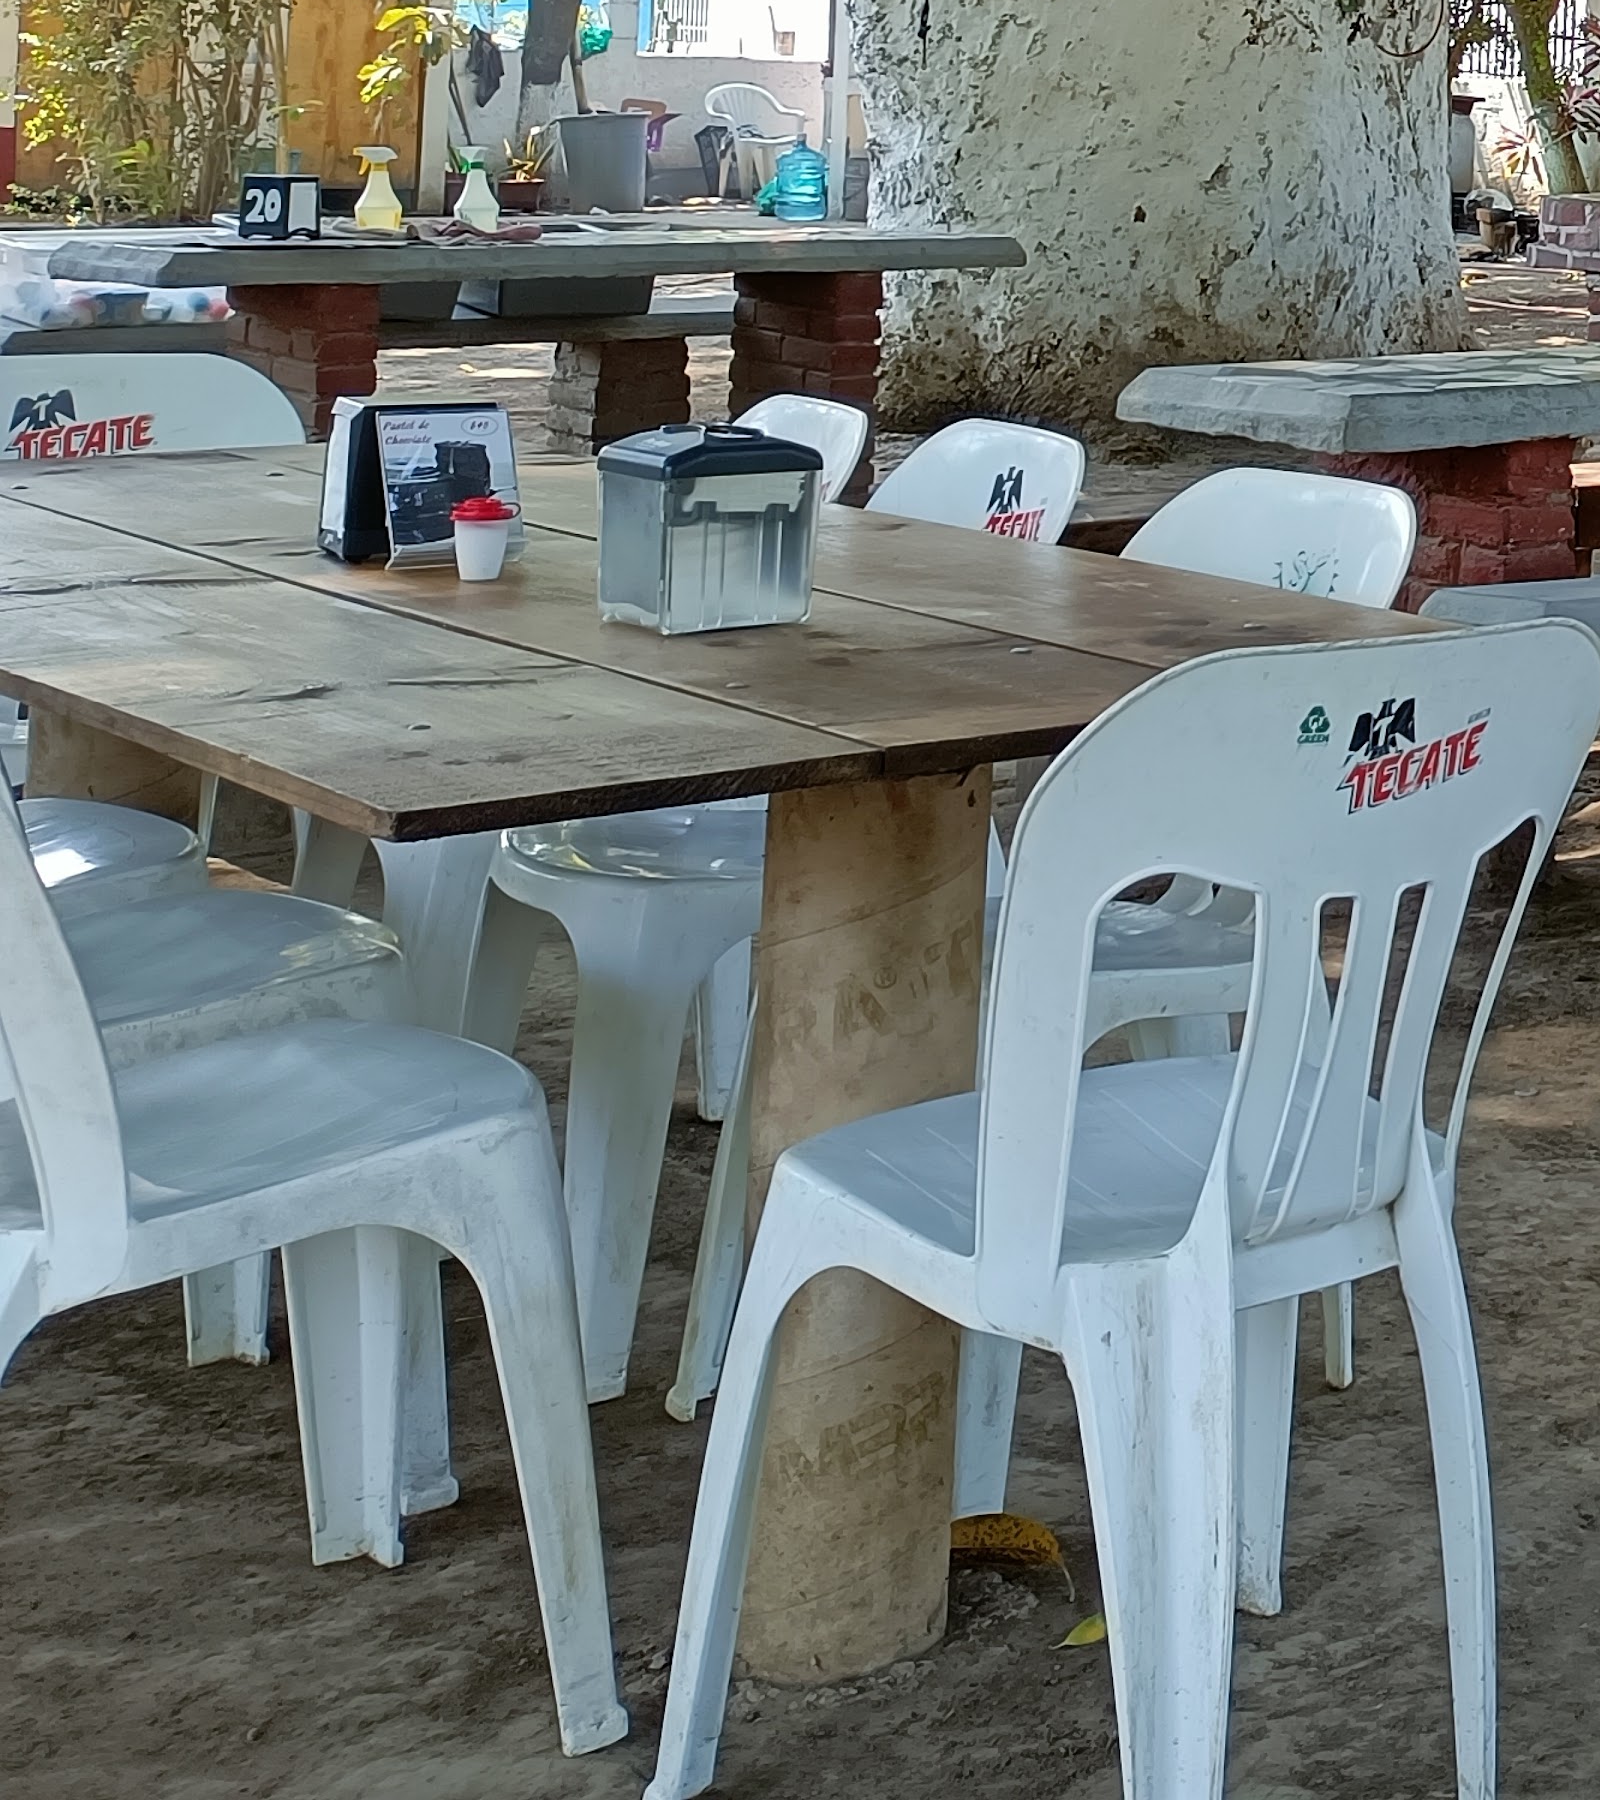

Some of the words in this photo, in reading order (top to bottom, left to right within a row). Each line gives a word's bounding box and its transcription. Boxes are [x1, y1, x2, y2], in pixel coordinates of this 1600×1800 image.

[245, 188, 282, 223] 20
[5, 414, 156, 459] TECATE
[1336, 720, 1490, 814] TECATE
